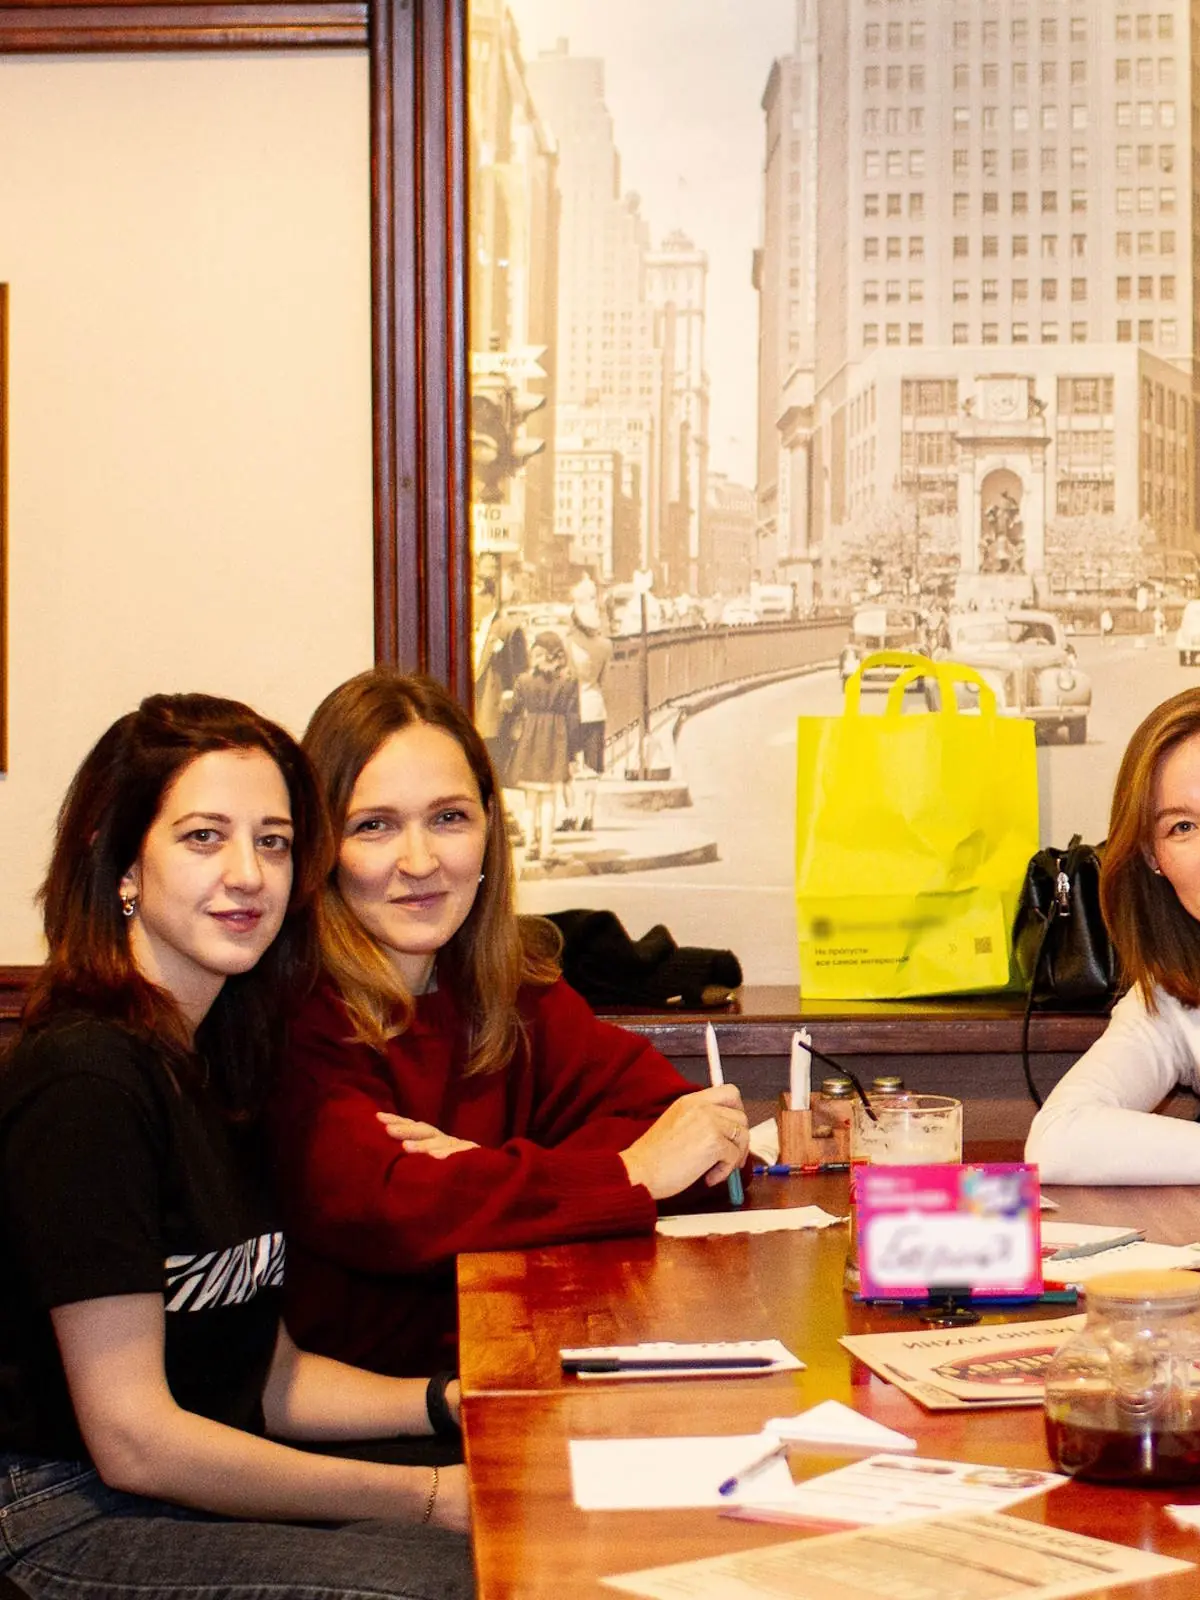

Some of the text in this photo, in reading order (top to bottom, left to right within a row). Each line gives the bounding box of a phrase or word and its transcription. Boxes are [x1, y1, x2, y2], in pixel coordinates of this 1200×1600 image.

[477, 508, 502, 521] NO
[902, 1324, 1075, 1350] МЕНЮ КУХНИ
